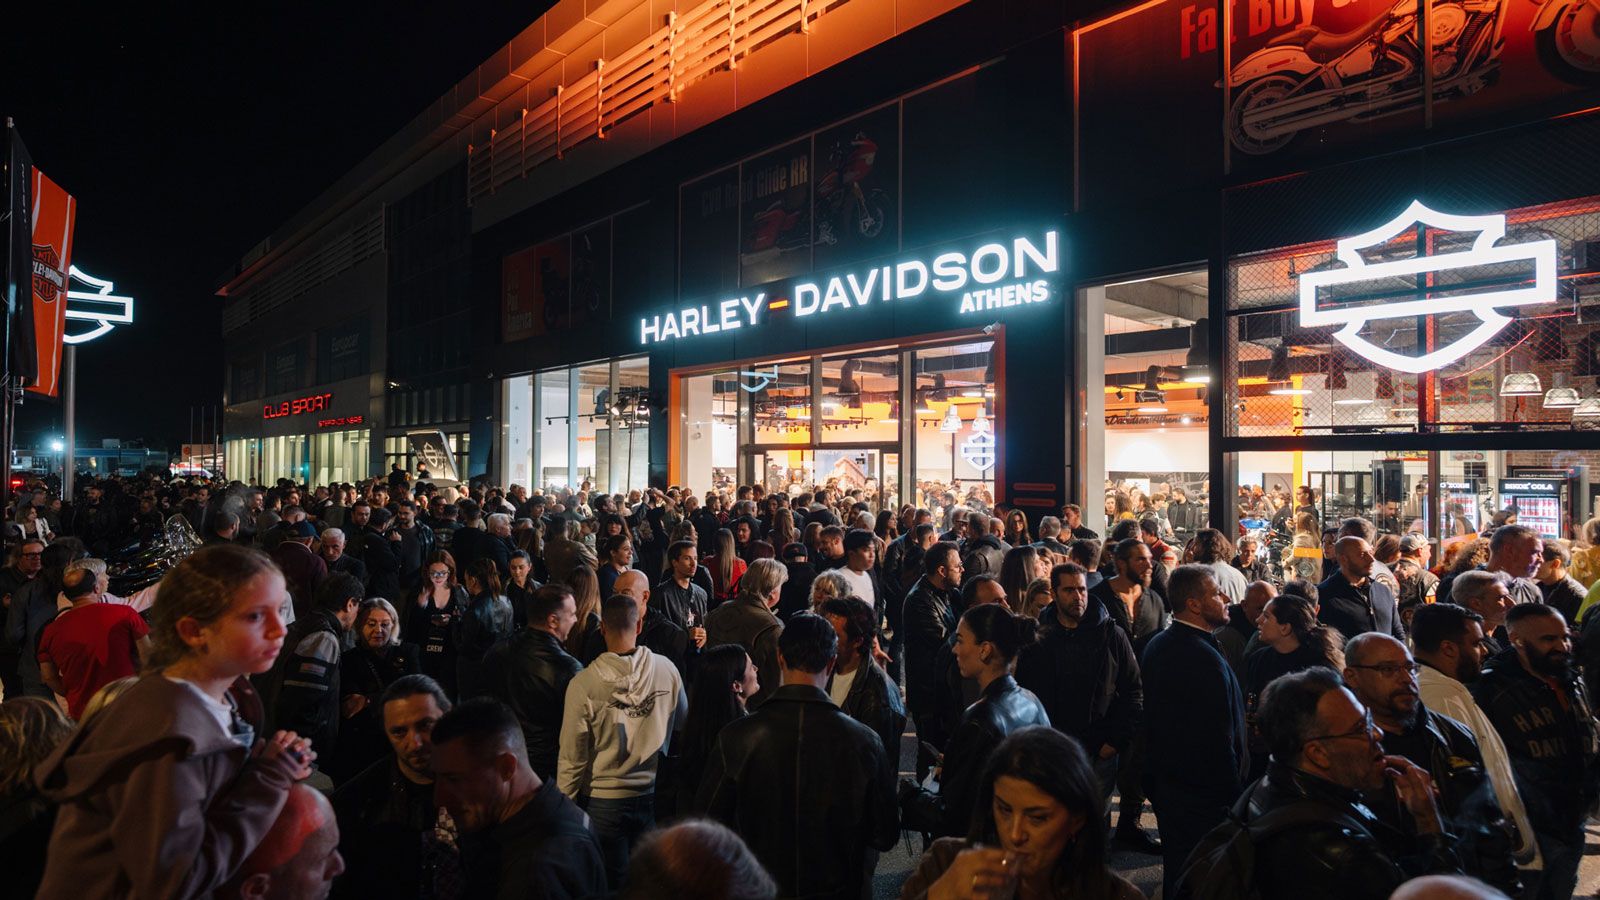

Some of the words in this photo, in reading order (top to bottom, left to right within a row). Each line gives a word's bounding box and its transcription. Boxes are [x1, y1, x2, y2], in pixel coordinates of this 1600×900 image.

[757, 165, 787, 198] Glide
[641, 231, 1058, 345] HARLEY-DAVIDSON
[959, 280, 1049, 314] ATHENS
[263, 401, 289, 419] CLUB
[292, 393, 332, 415] SPORT
